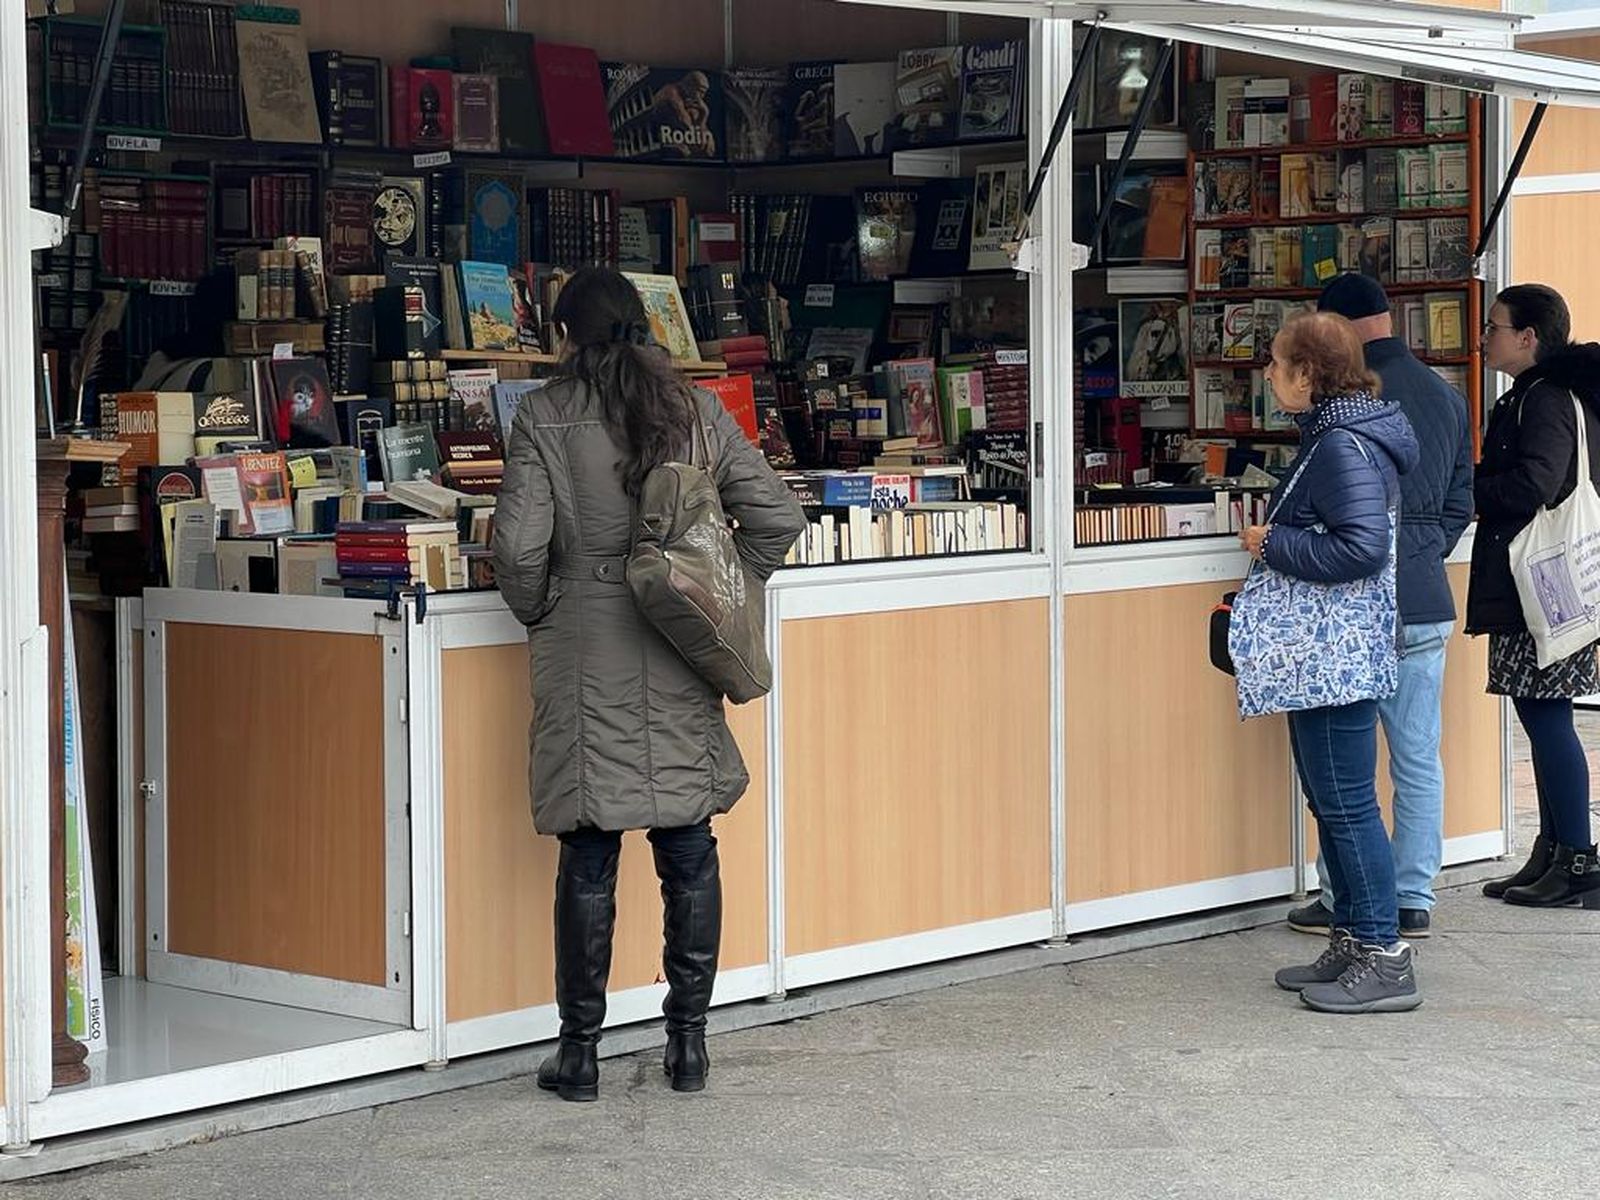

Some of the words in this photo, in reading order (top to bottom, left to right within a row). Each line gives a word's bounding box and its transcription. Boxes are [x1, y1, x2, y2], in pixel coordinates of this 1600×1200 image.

[660, 125, 714, 145] Rodin
[118, 410, 156, 434] HUMOR
[386, 438, 397, 448] La
[398, 435, 424, 445] mente
[871, 490, 908, 508] noche
[874, 486, 890, 497] esta
